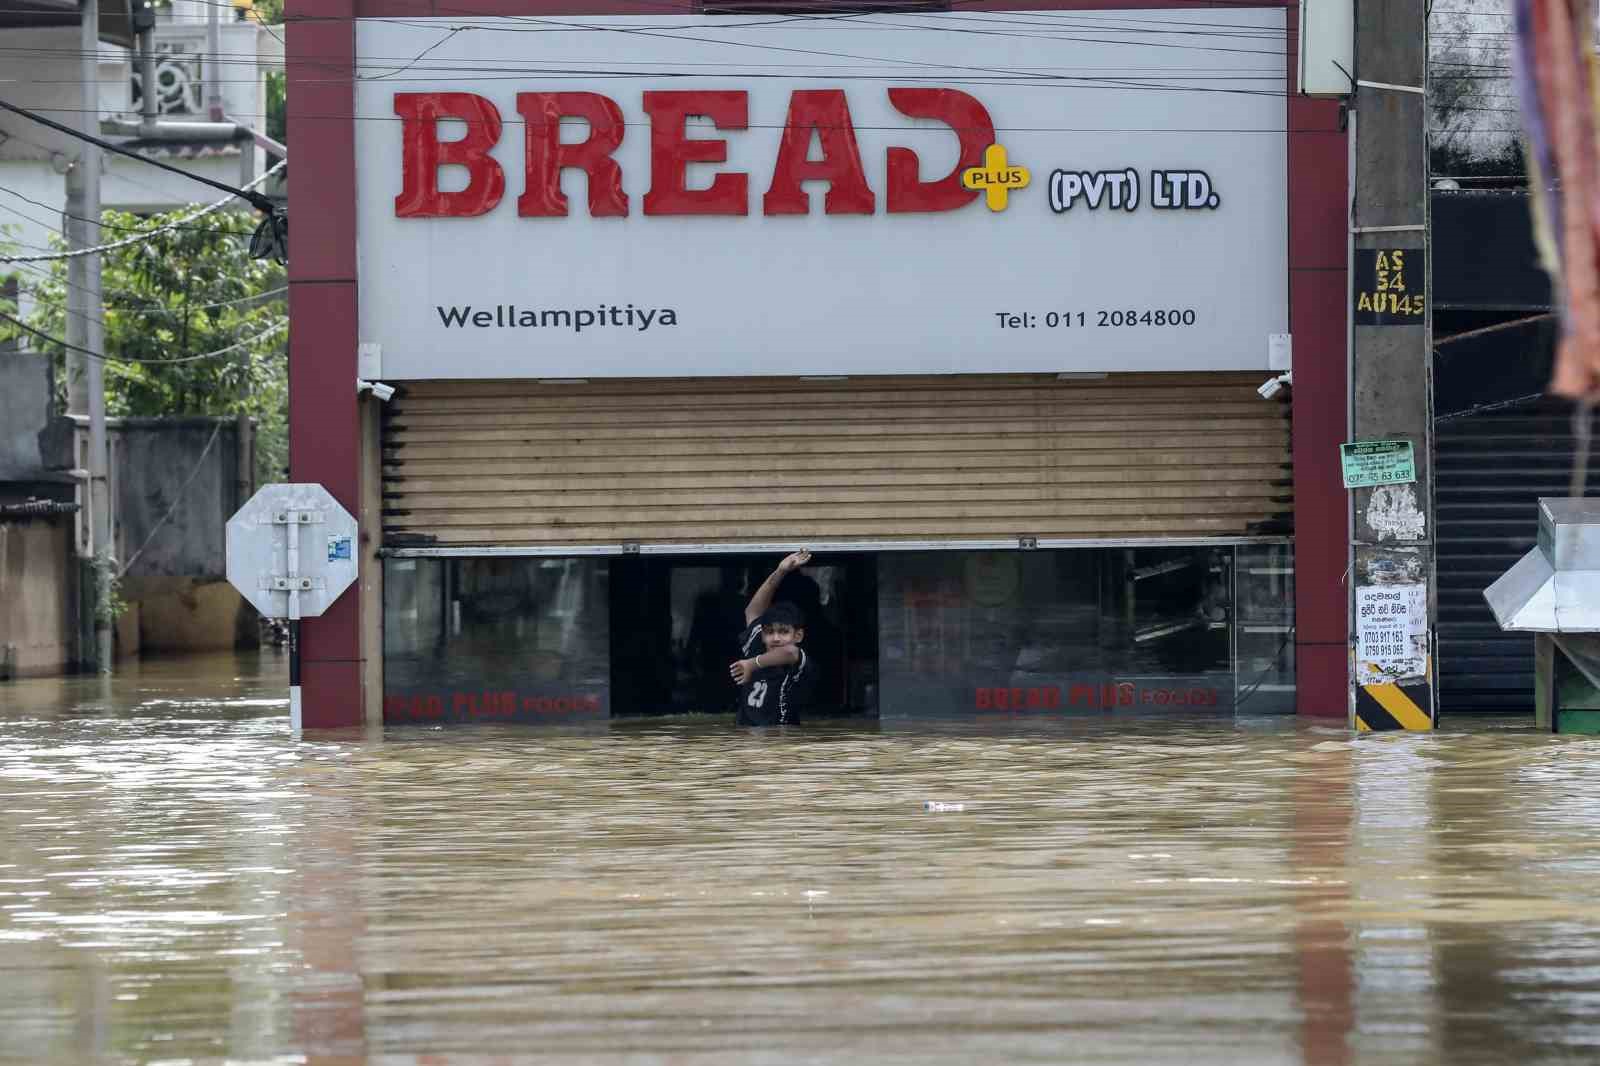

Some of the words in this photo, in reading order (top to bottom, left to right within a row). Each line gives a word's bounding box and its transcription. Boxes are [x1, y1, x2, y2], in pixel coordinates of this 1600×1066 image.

[393, 88, 996, 218] BREAD
[972, 171, 1021, 185] PLUS
[1049, 168, 1140, 213] (PVT)
[1151, 170, 1220, 210] LTD.
[1376, 250, 1404, 270] AS
[1377, 271, 1405, 291] 54
[1358, 292, 1424, 315] AU145
[437, 305, 678, 332] Wellampitiya
[996, 312, 1036, 329] Tel:
[1046, 312, 1086, 328] 011
[1097, 310, 1196, 327] 2084800
